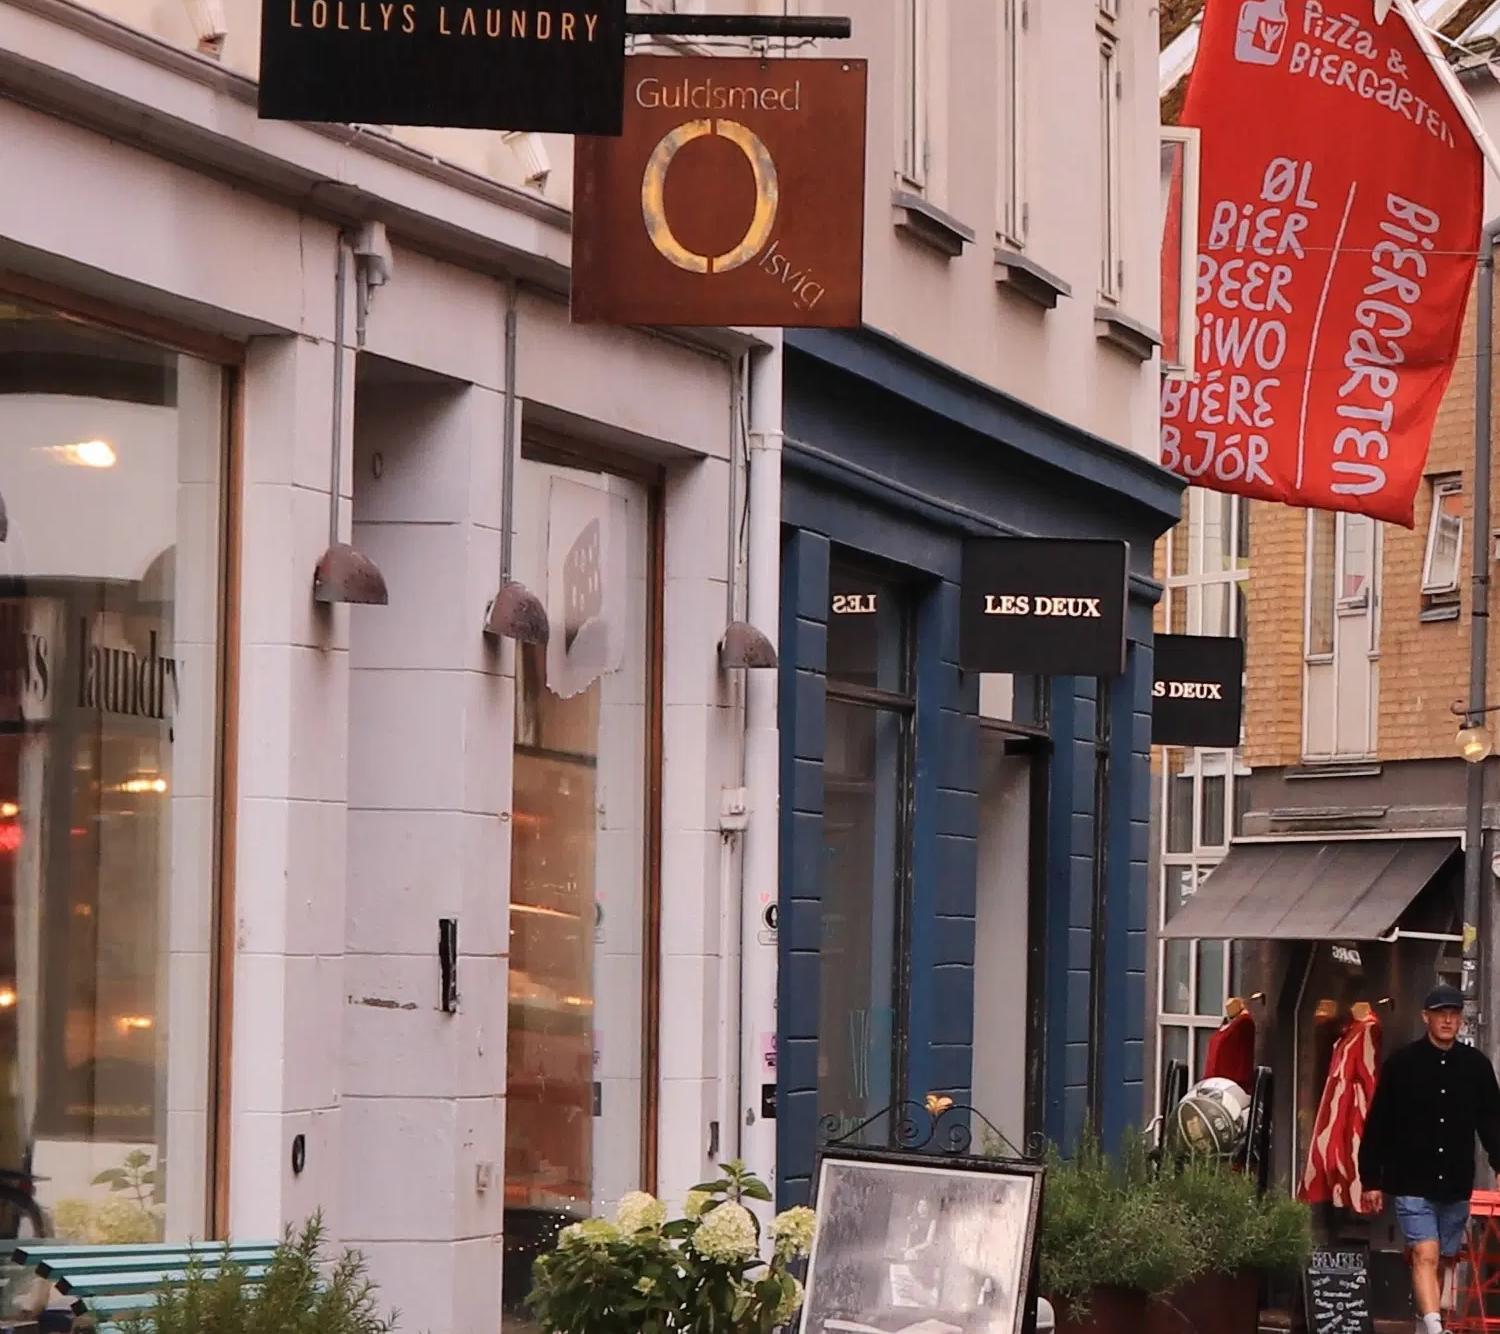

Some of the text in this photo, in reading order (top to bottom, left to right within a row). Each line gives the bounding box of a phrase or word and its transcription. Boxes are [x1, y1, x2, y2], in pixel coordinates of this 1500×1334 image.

[290, 0, 598, 42] LOLLYS LAUNDRY
[1386, 47, 1409, 80] &
[635, 77, 800, 111] Guldsmed
[1260, 157, 1319, 210] ØL
[1160, 425, 1275, 486] BJÓR
[984, 595, 1101, 618] LES DEUX
[1168, 681, 1222, 700] DEUX
